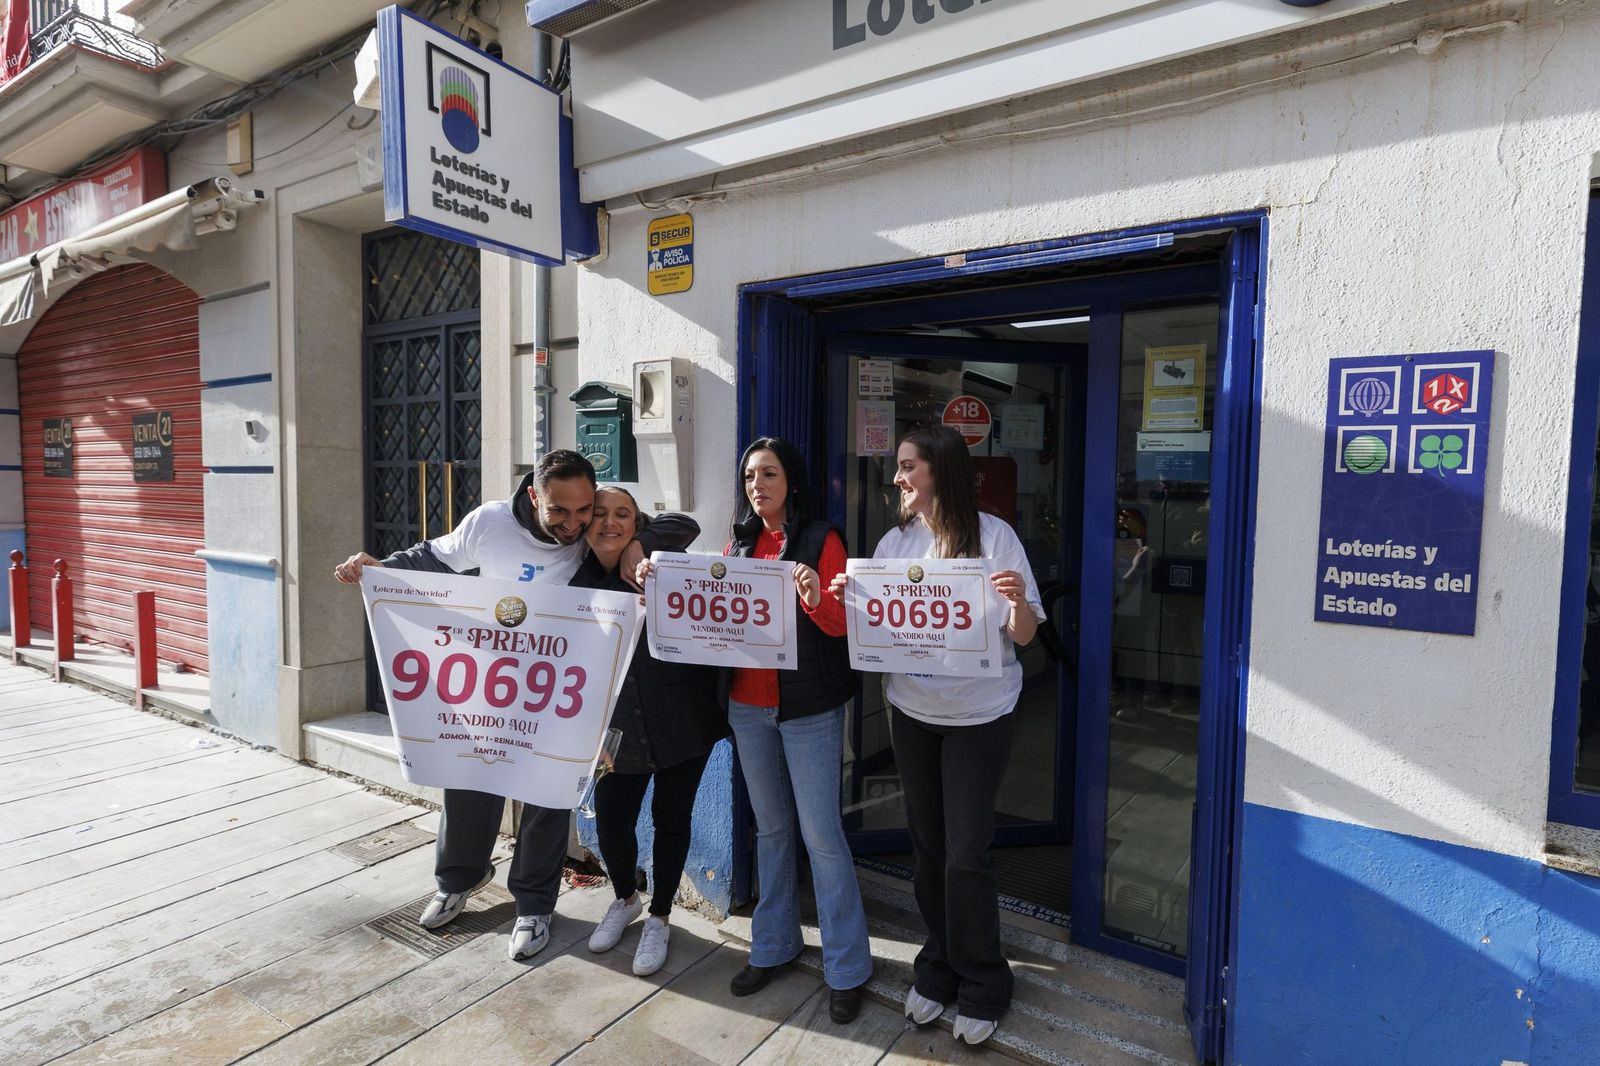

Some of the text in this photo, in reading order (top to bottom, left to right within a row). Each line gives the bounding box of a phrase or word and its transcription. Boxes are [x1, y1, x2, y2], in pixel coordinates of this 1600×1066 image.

[430, 146, 510, 193] Loterías y
[432, 170, 533, 219] Apuestas del
[432, 191, 489, 223] Estado
[661, 227, 690, 240] SECUR
[664, 248, 683, 258] AVISO
[1429, 380, 1439, 397] 1
[1449, 377, 1464, 399] X
[952, 402, 980, 418] +18
[134, 423, 157, 442] VENTA
[1326, 538, 1438, 565] Loterías y
[699, 580, 752, 595] PREMIO
[1324, 566, 1471, 593] Apuestas del
[404, 587, 414, 595] de
[897, 585, 951, 597] PREMIO
[667, 591, 771, 626] 90693
[866, 599, 972, 630] 90693
[1323, 595, 1397, 618] Estado
[691, 625, 723, 633] VENDIDO
[891, 632, 923, 640] VENDIDO
[467, 627, 568, 658] PREMIO
[392, 649, 587, 719] 90693
[438, 713, 539, 735] VENDIDO AQUÍ
[474, 747, 497, 756] SANTA
[494, 737, 514, 746] REINA
[515, 740, 533, 749] ISABEL
